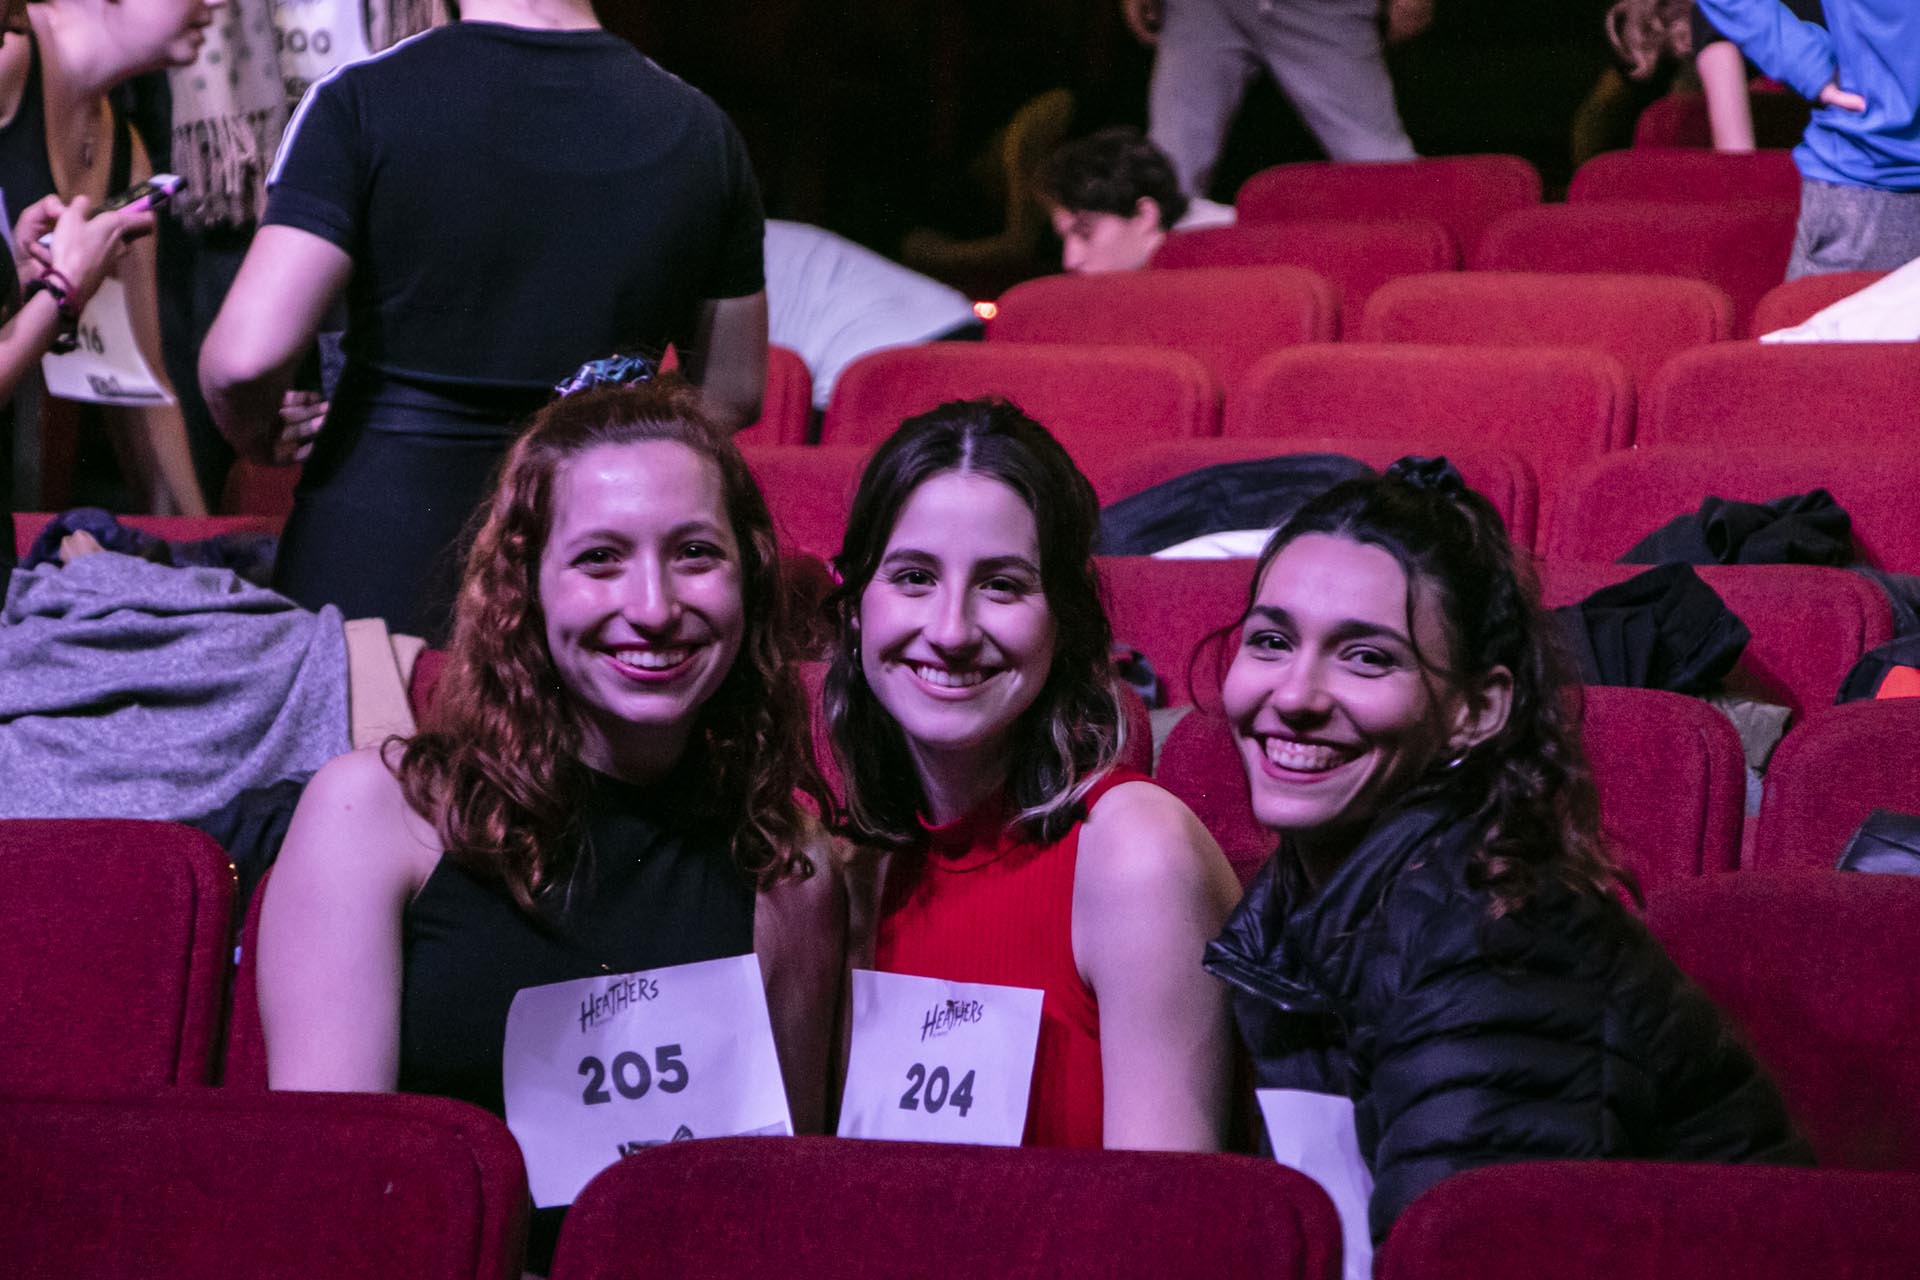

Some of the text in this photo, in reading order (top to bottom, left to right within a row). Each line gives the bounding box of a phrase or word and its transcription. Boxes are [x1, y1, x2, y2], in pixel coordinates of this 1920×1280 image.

[579, 977, 659, 1033] HEATHERS
[921, 1000, 984, 1043] HEATHERS
[577, 1043, 690, 1106] 205
[899, 1063, 976, 1117] 204
